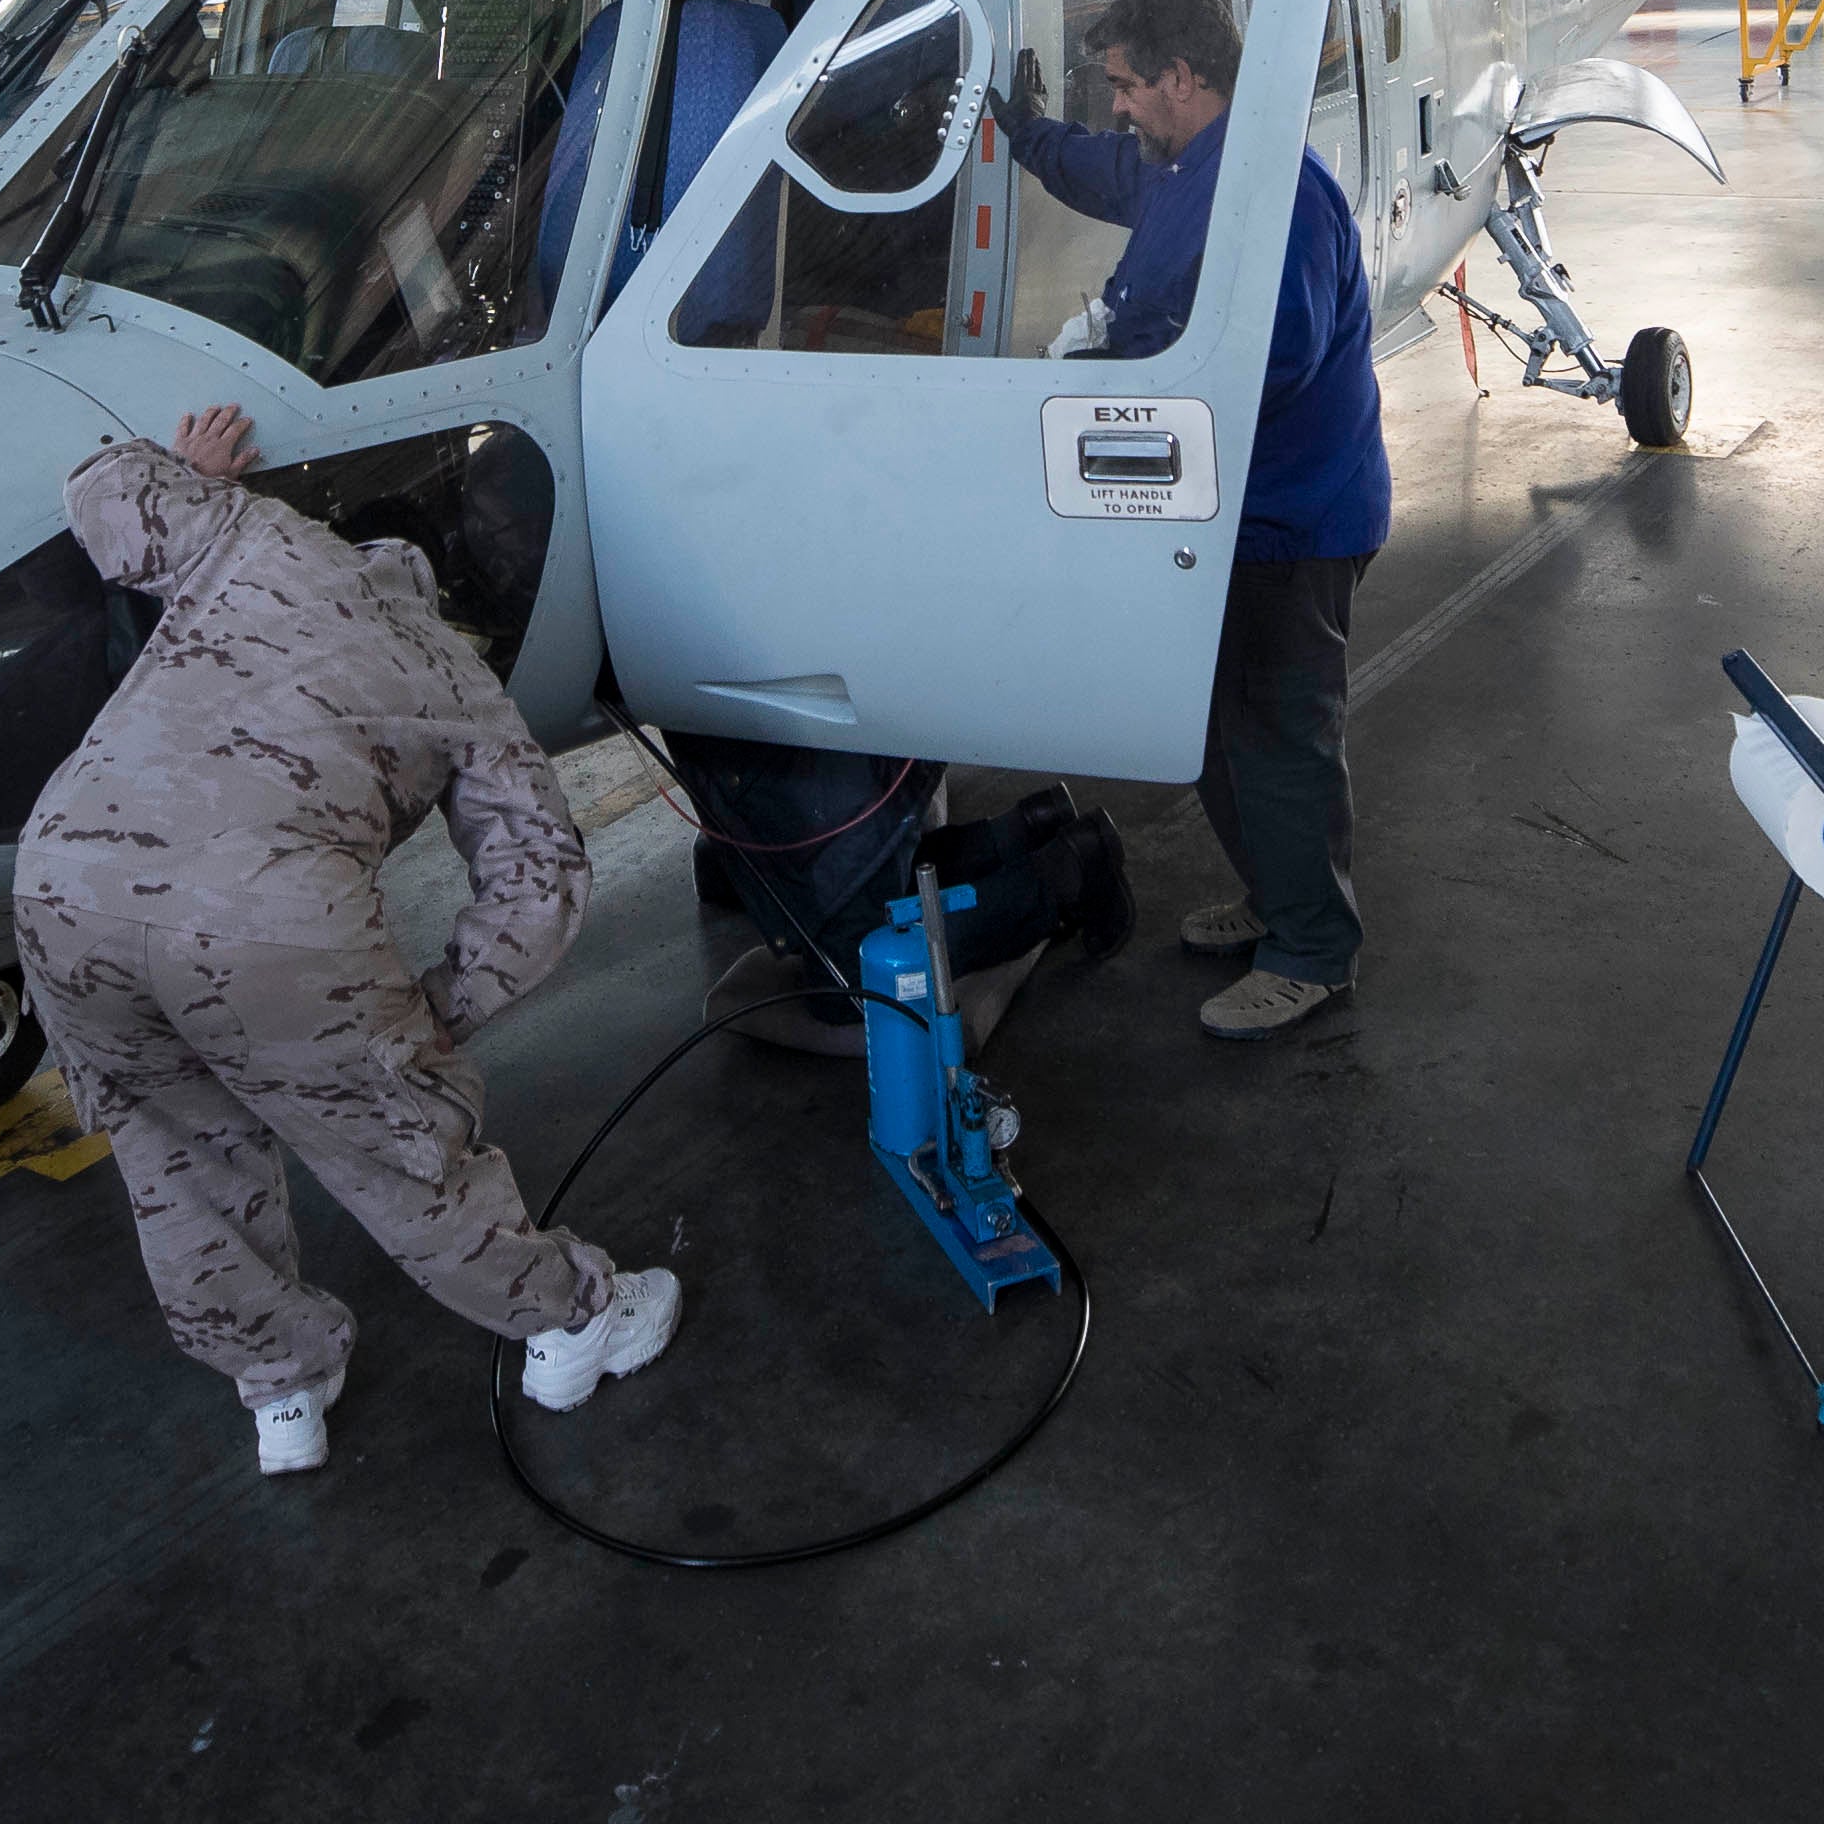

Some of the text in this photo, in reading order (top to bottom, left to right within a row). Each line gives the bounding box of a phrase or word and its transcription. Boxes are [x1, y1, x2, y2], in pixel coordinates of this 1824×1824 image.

[1094, 407, 1158, 423] EXIT
[1091, 489, 1174, 501] LIFT HANDLE
[1104, 504, 1163, 515] TO OPEN
